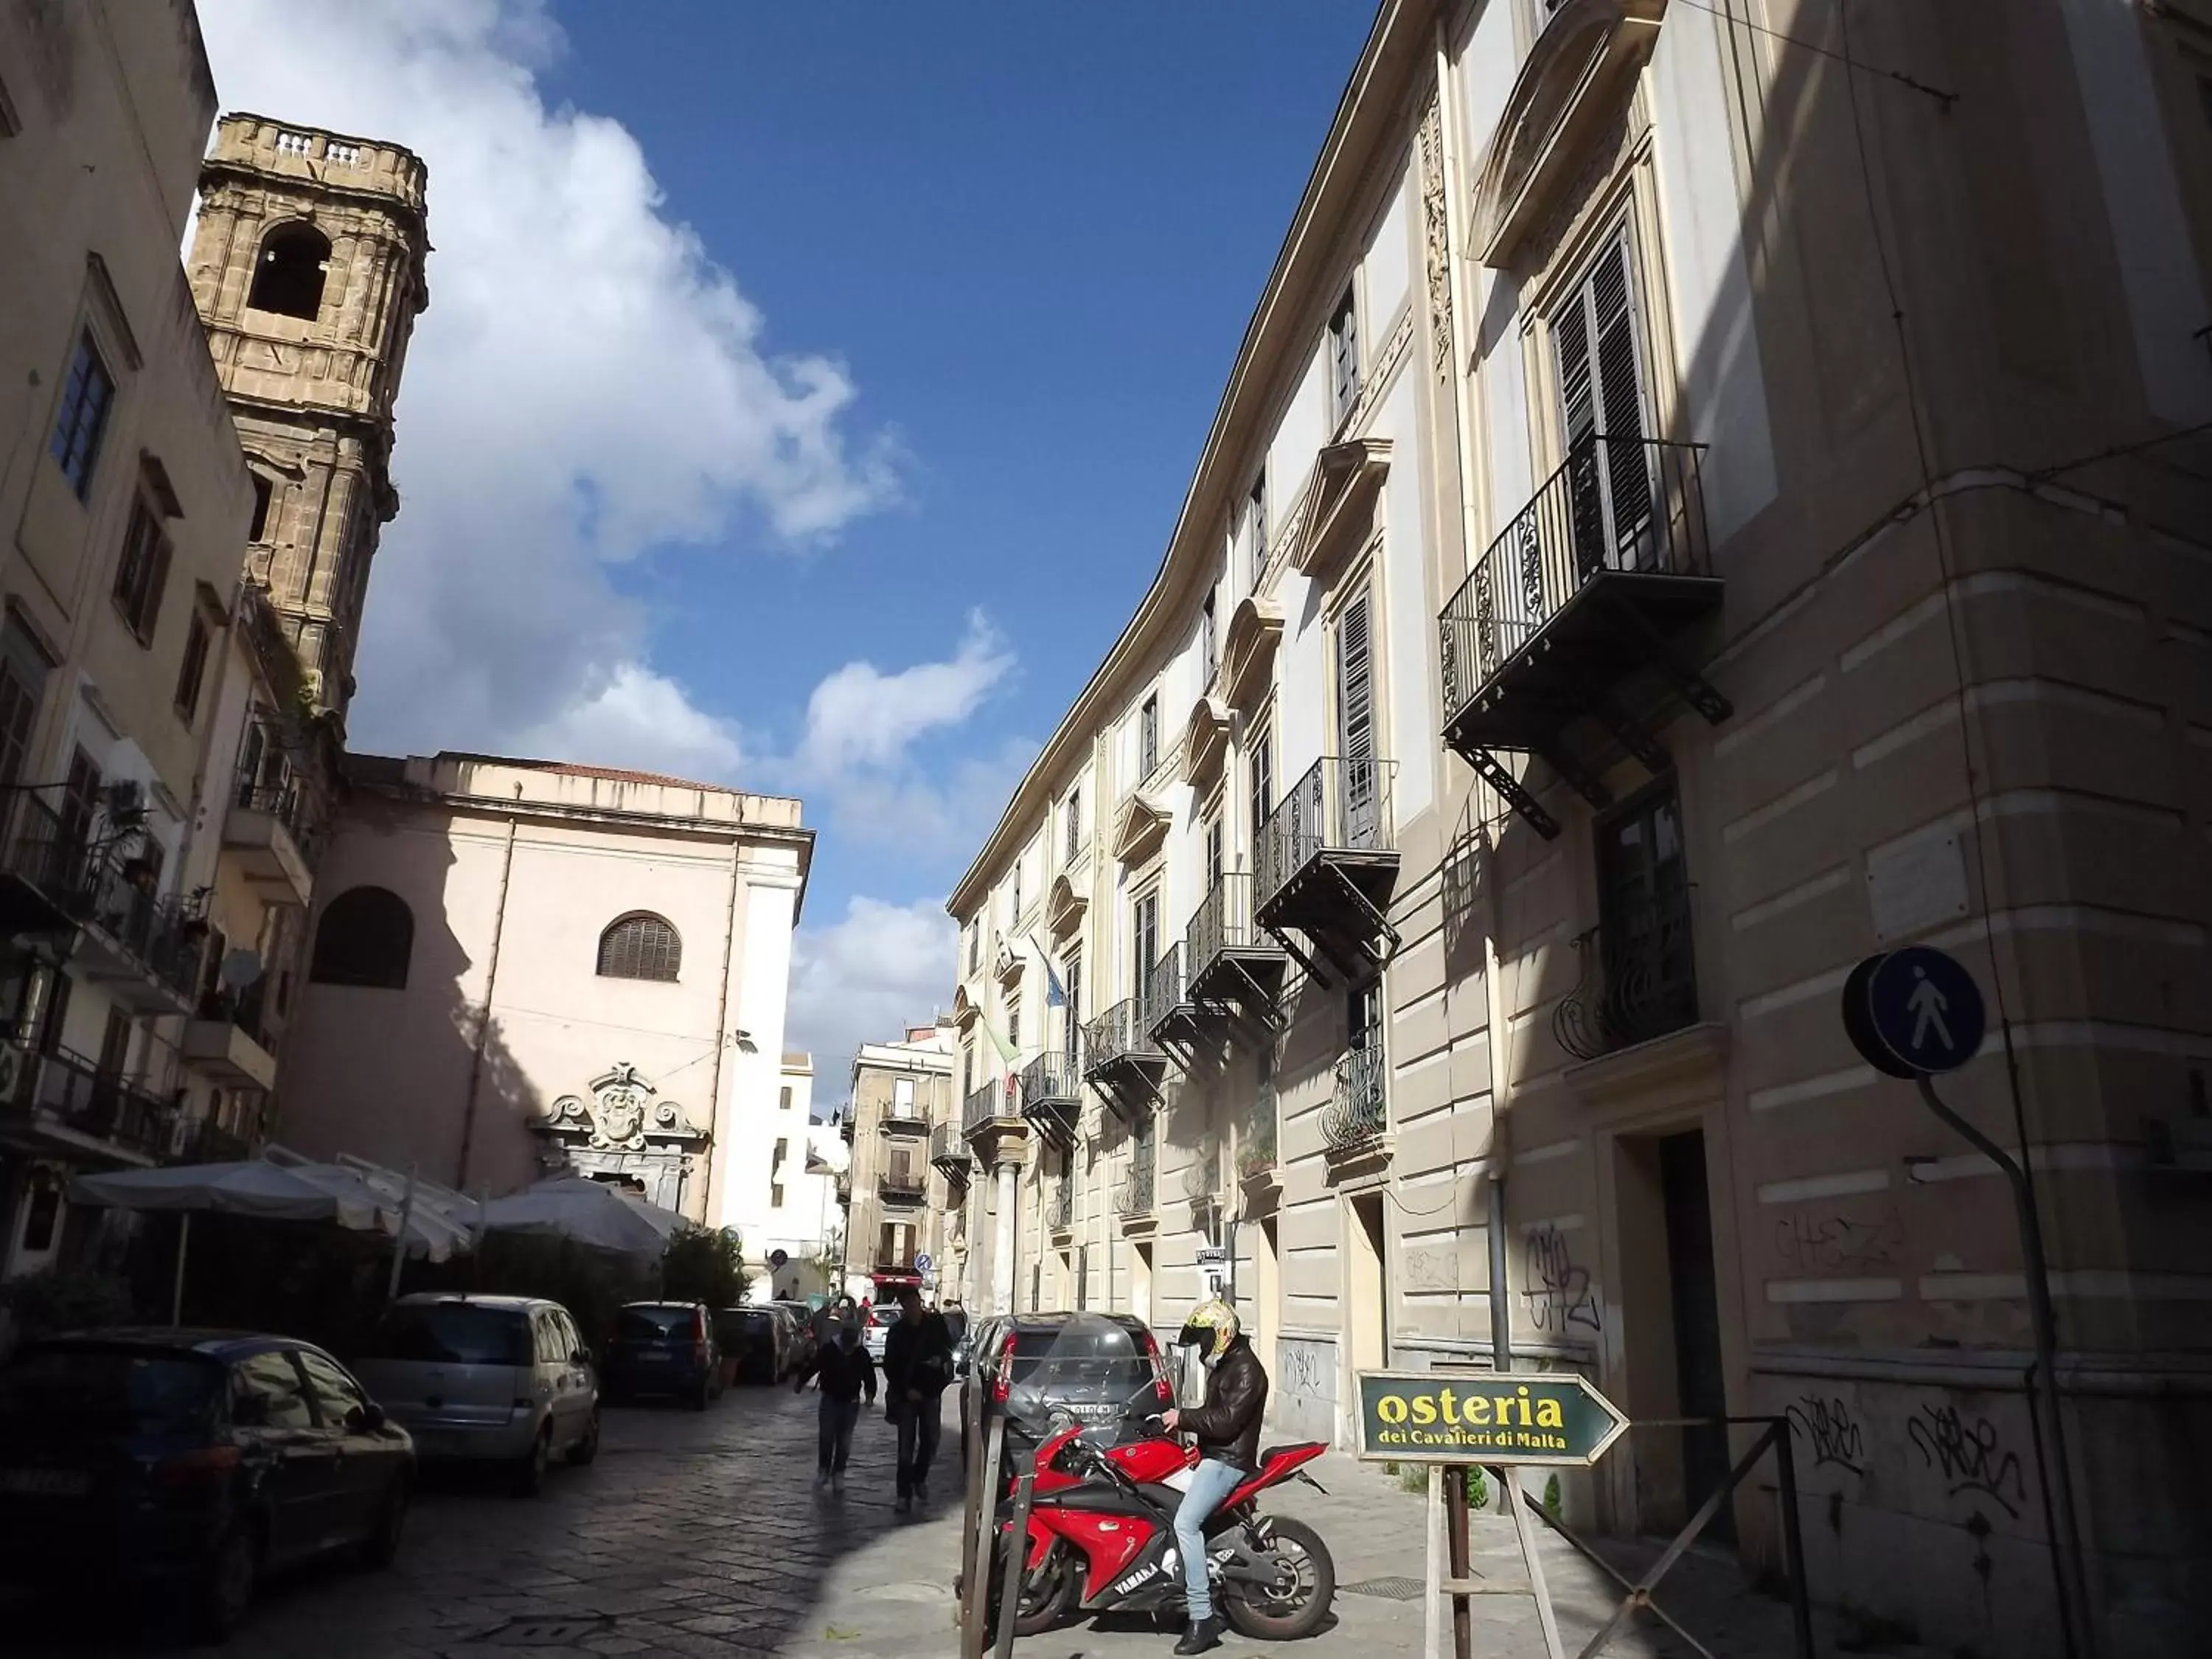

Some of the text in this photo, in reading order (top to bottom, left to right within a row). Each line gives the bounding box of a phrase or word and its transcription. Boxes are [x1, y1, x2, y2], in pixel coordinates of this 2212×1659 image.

[1377, 1386, 1563, 1428] osteria
[1379, 1428, 1566, 1449] dei Cavalieri di Malta
